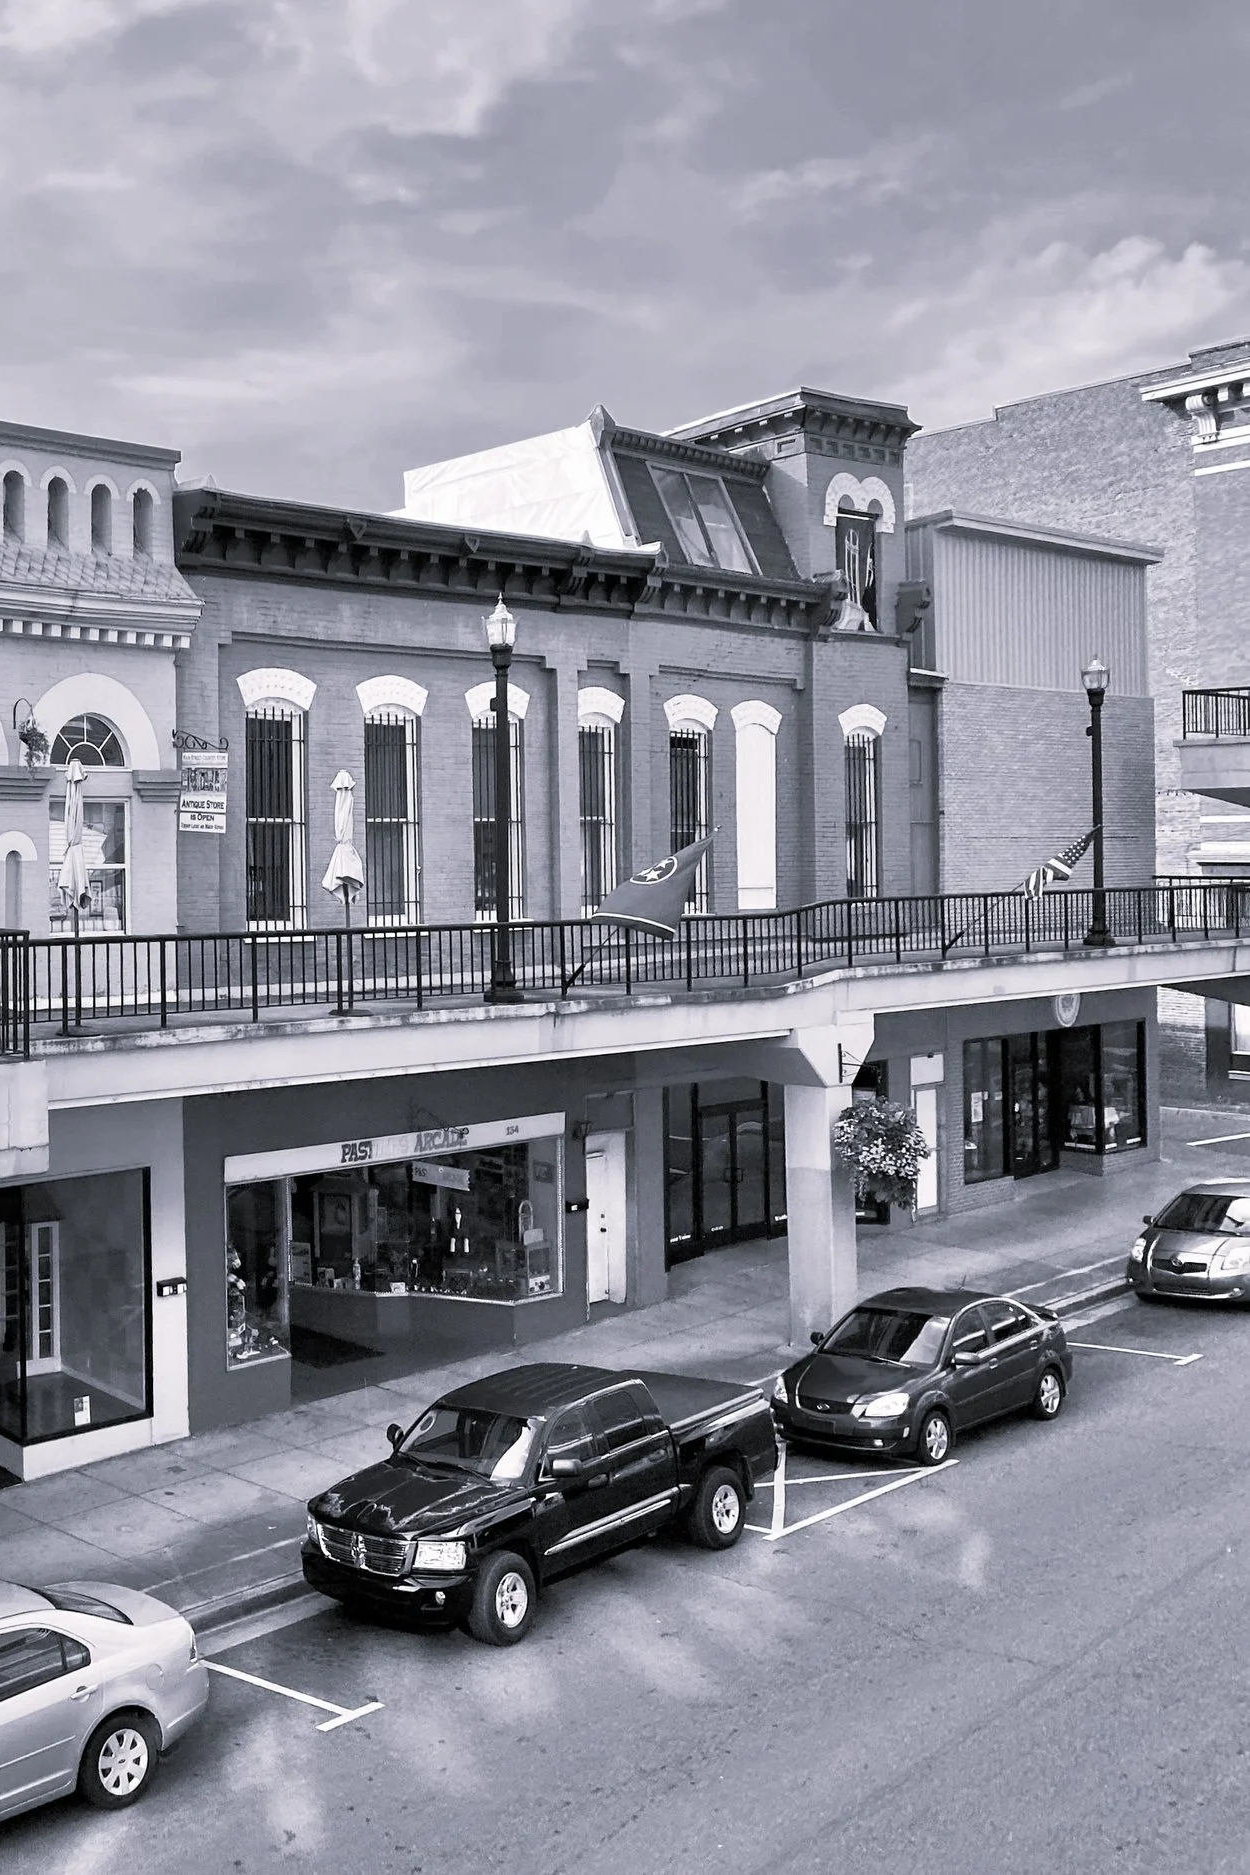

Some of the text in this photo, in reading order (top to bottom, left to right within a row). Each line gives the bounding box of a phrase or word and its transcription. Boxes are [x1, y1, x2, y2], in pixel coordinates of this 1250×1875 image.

[182, 800, 224, 809] ANTIQUE STORE
[197, 813, 214, 821] OPEN
[506, 1125, 519, 1136] 134
